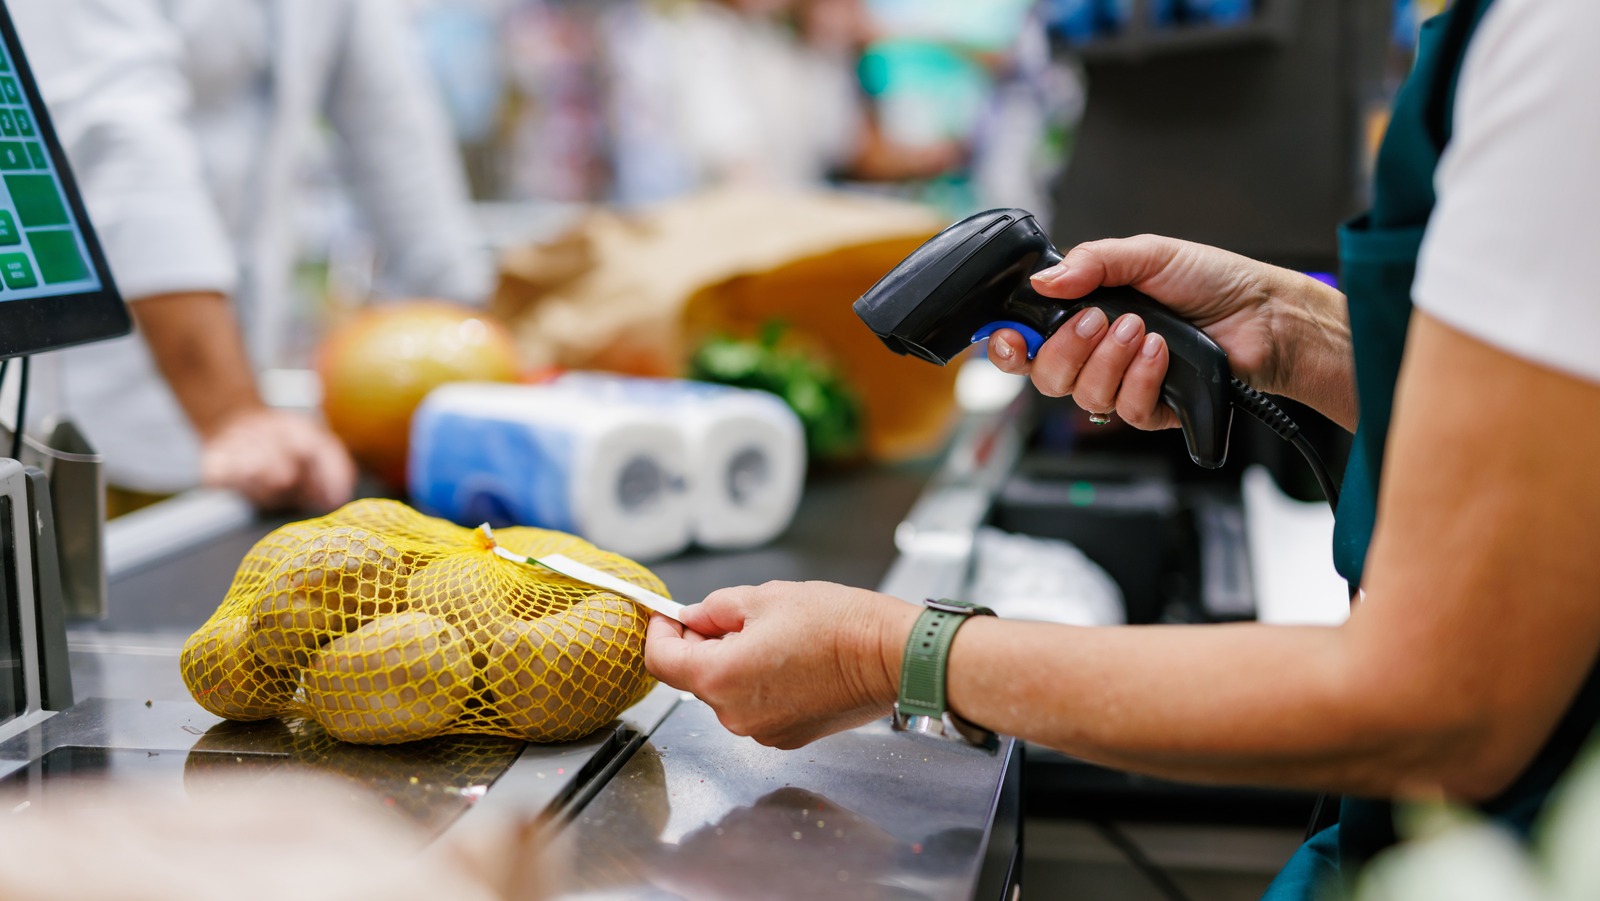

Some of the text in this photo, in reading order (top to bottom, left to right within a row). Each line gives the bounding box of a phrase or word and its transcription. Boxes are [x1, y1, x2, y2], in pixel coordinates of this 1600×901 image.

[2, 114, 28, 129] 2 3
[7, 149, 16, 164] 0
